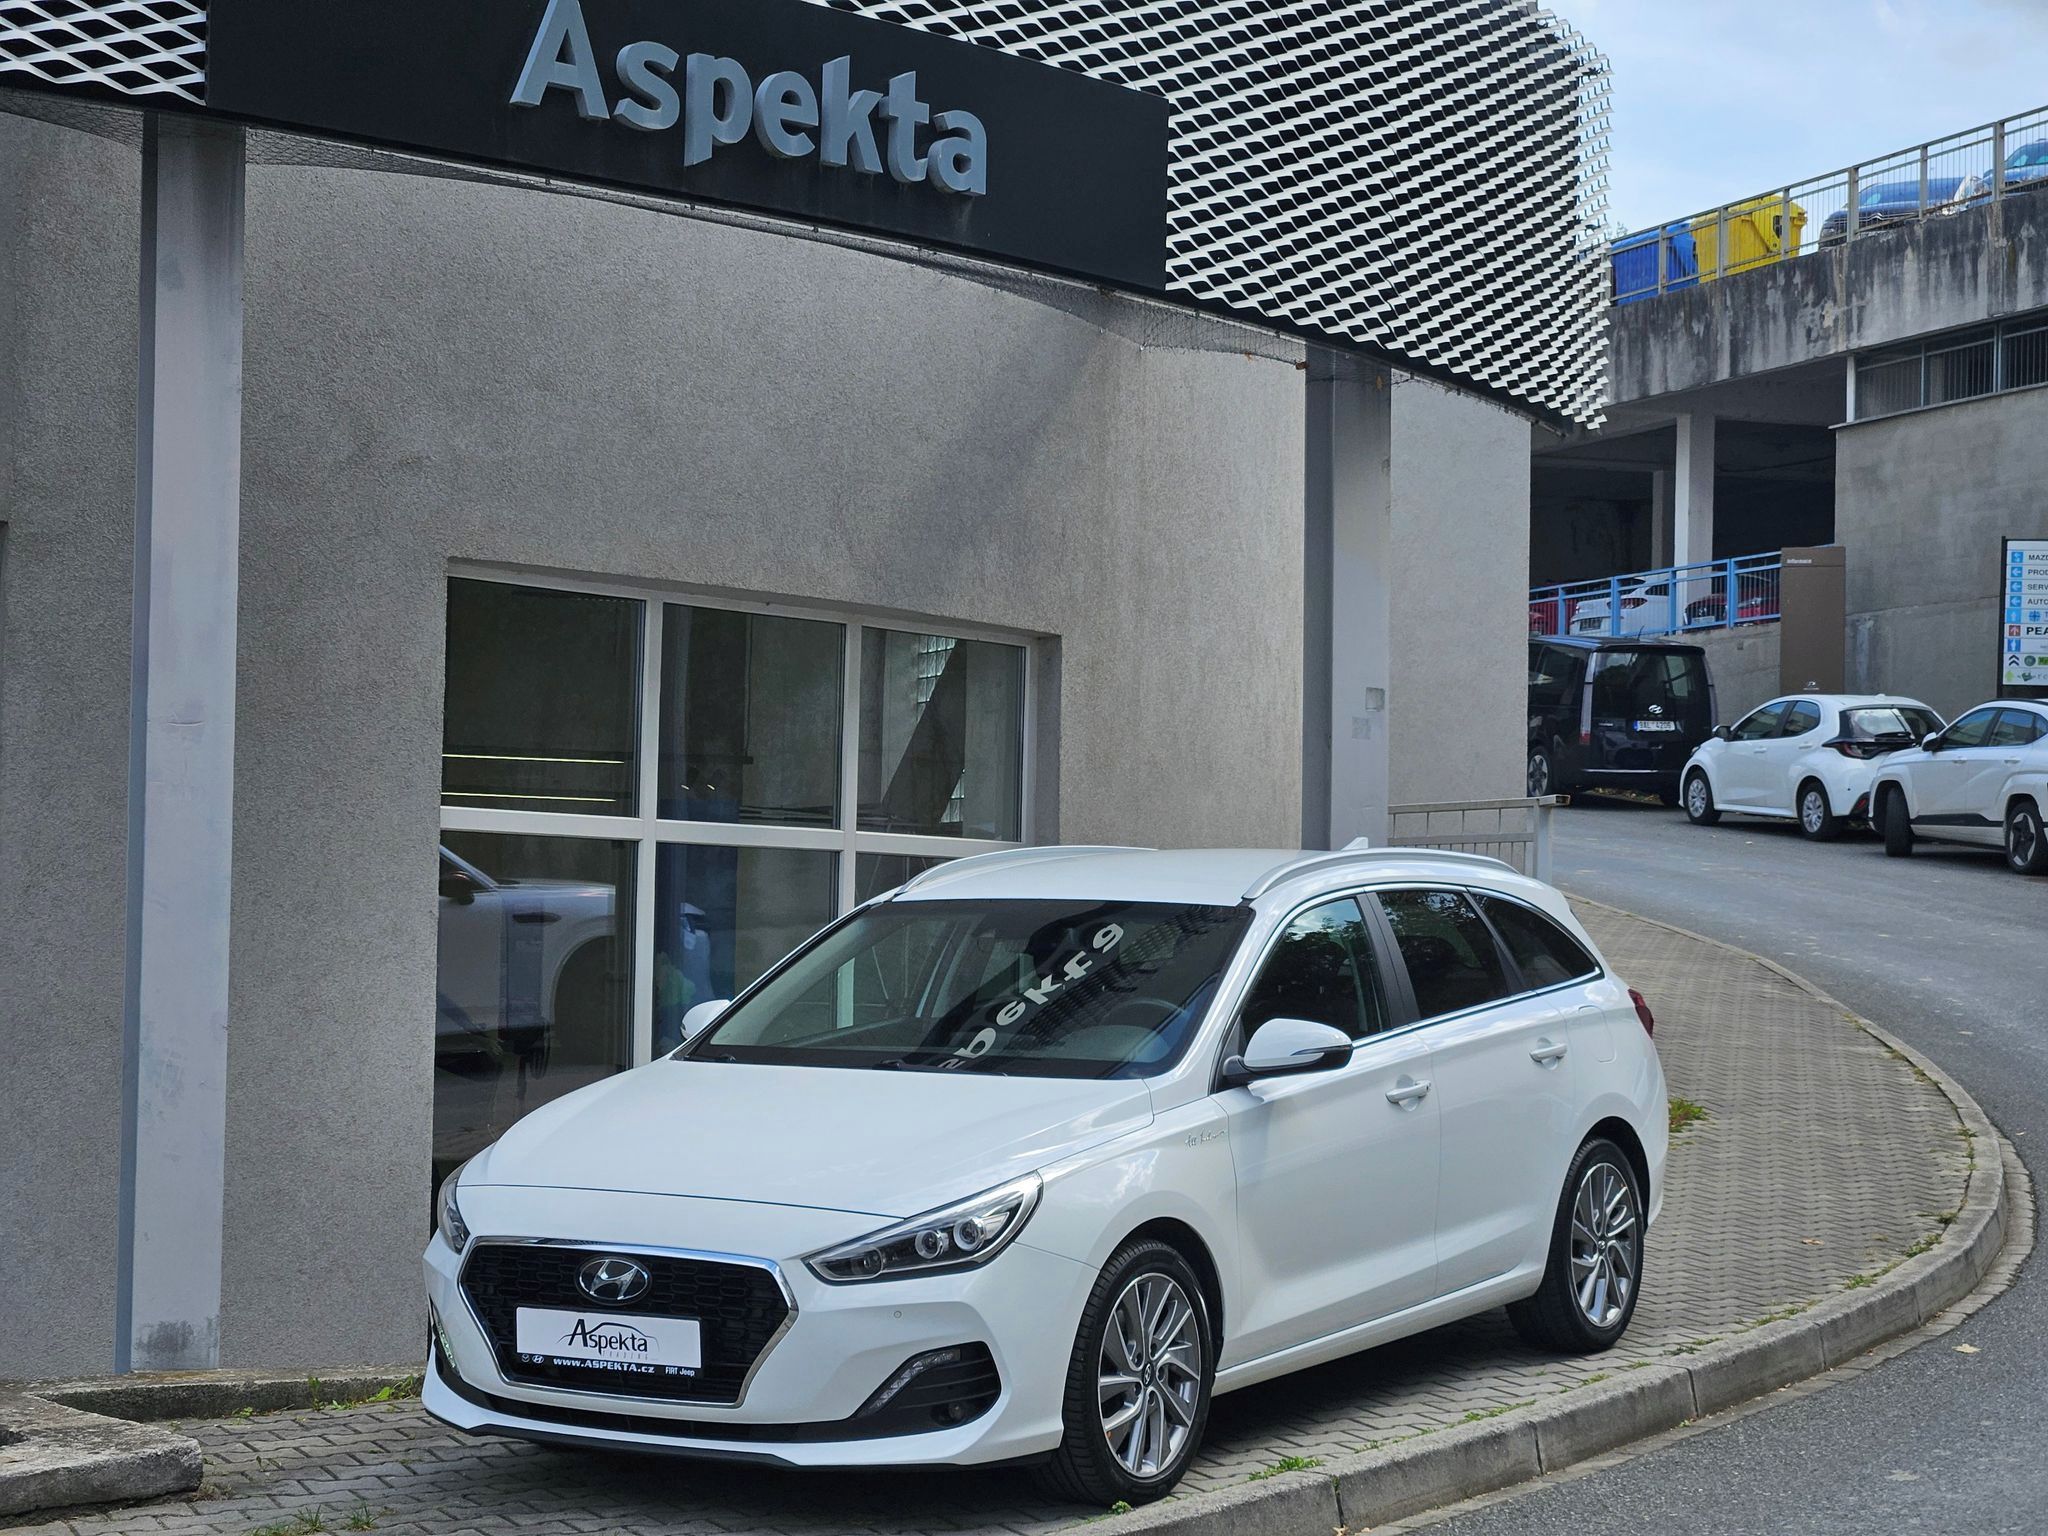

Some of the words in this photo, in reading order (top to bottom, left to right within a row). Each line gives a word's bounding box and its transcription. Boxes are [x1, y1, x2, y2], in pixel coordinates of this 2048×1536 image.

[509, 0, 987, 196] Aspekta
[568, 1319, 648, 1355] Aspekta
[553, 1358, 655, 1373] www.ASPEKTA.cz
[665, 1366, 678, 1375] FIAT
[679, 1367, 696, 1378] Jeep
